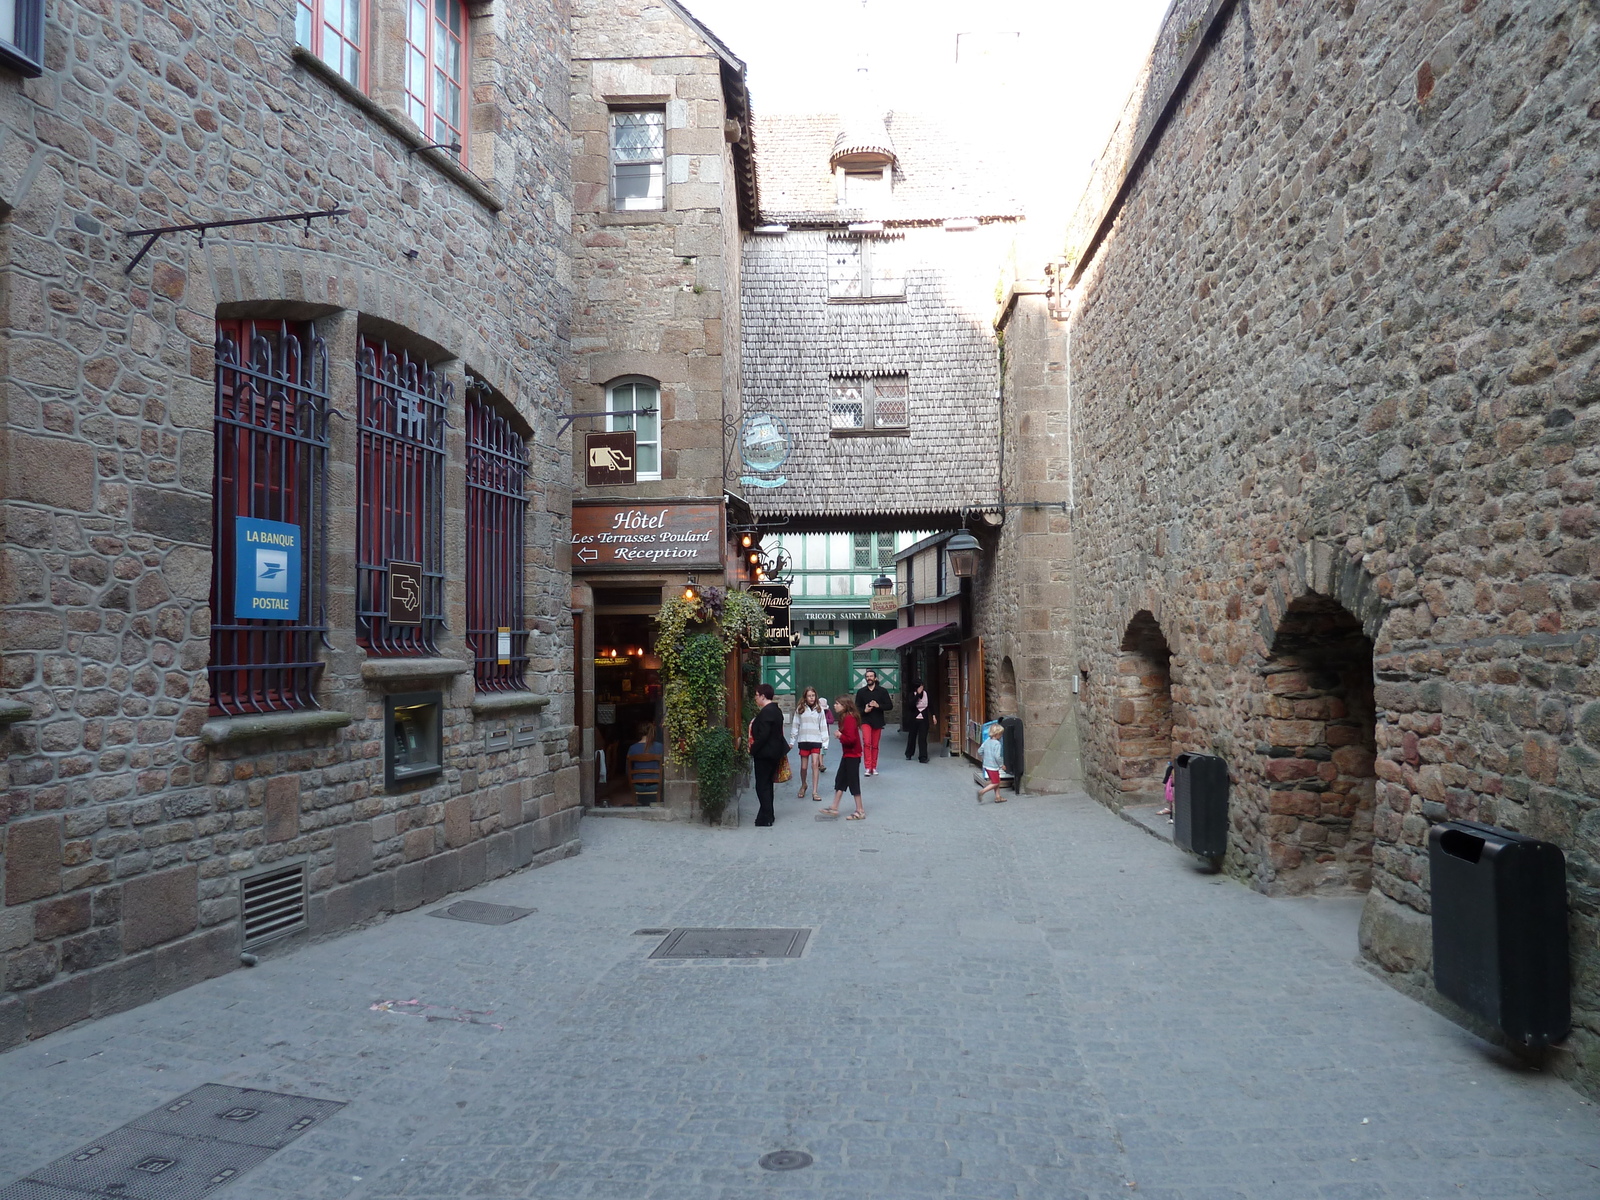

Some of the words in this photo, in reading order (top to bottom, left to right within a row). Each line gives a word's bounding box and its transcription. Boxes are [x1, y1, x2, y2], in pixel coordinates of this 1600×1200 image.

[612, 509, 669, 529] Hôtel
[246, 530, 260, 543] LA
[260, 532, 295, 546] BANQUE
[571, 533, 594, 544] Les
[597, 531, 656, 543] Terrasses
[659, 530, 713, 542] Poulard
[613, 546, 698, 563] Réception
[252, 597, 289, 610] POSTALE
